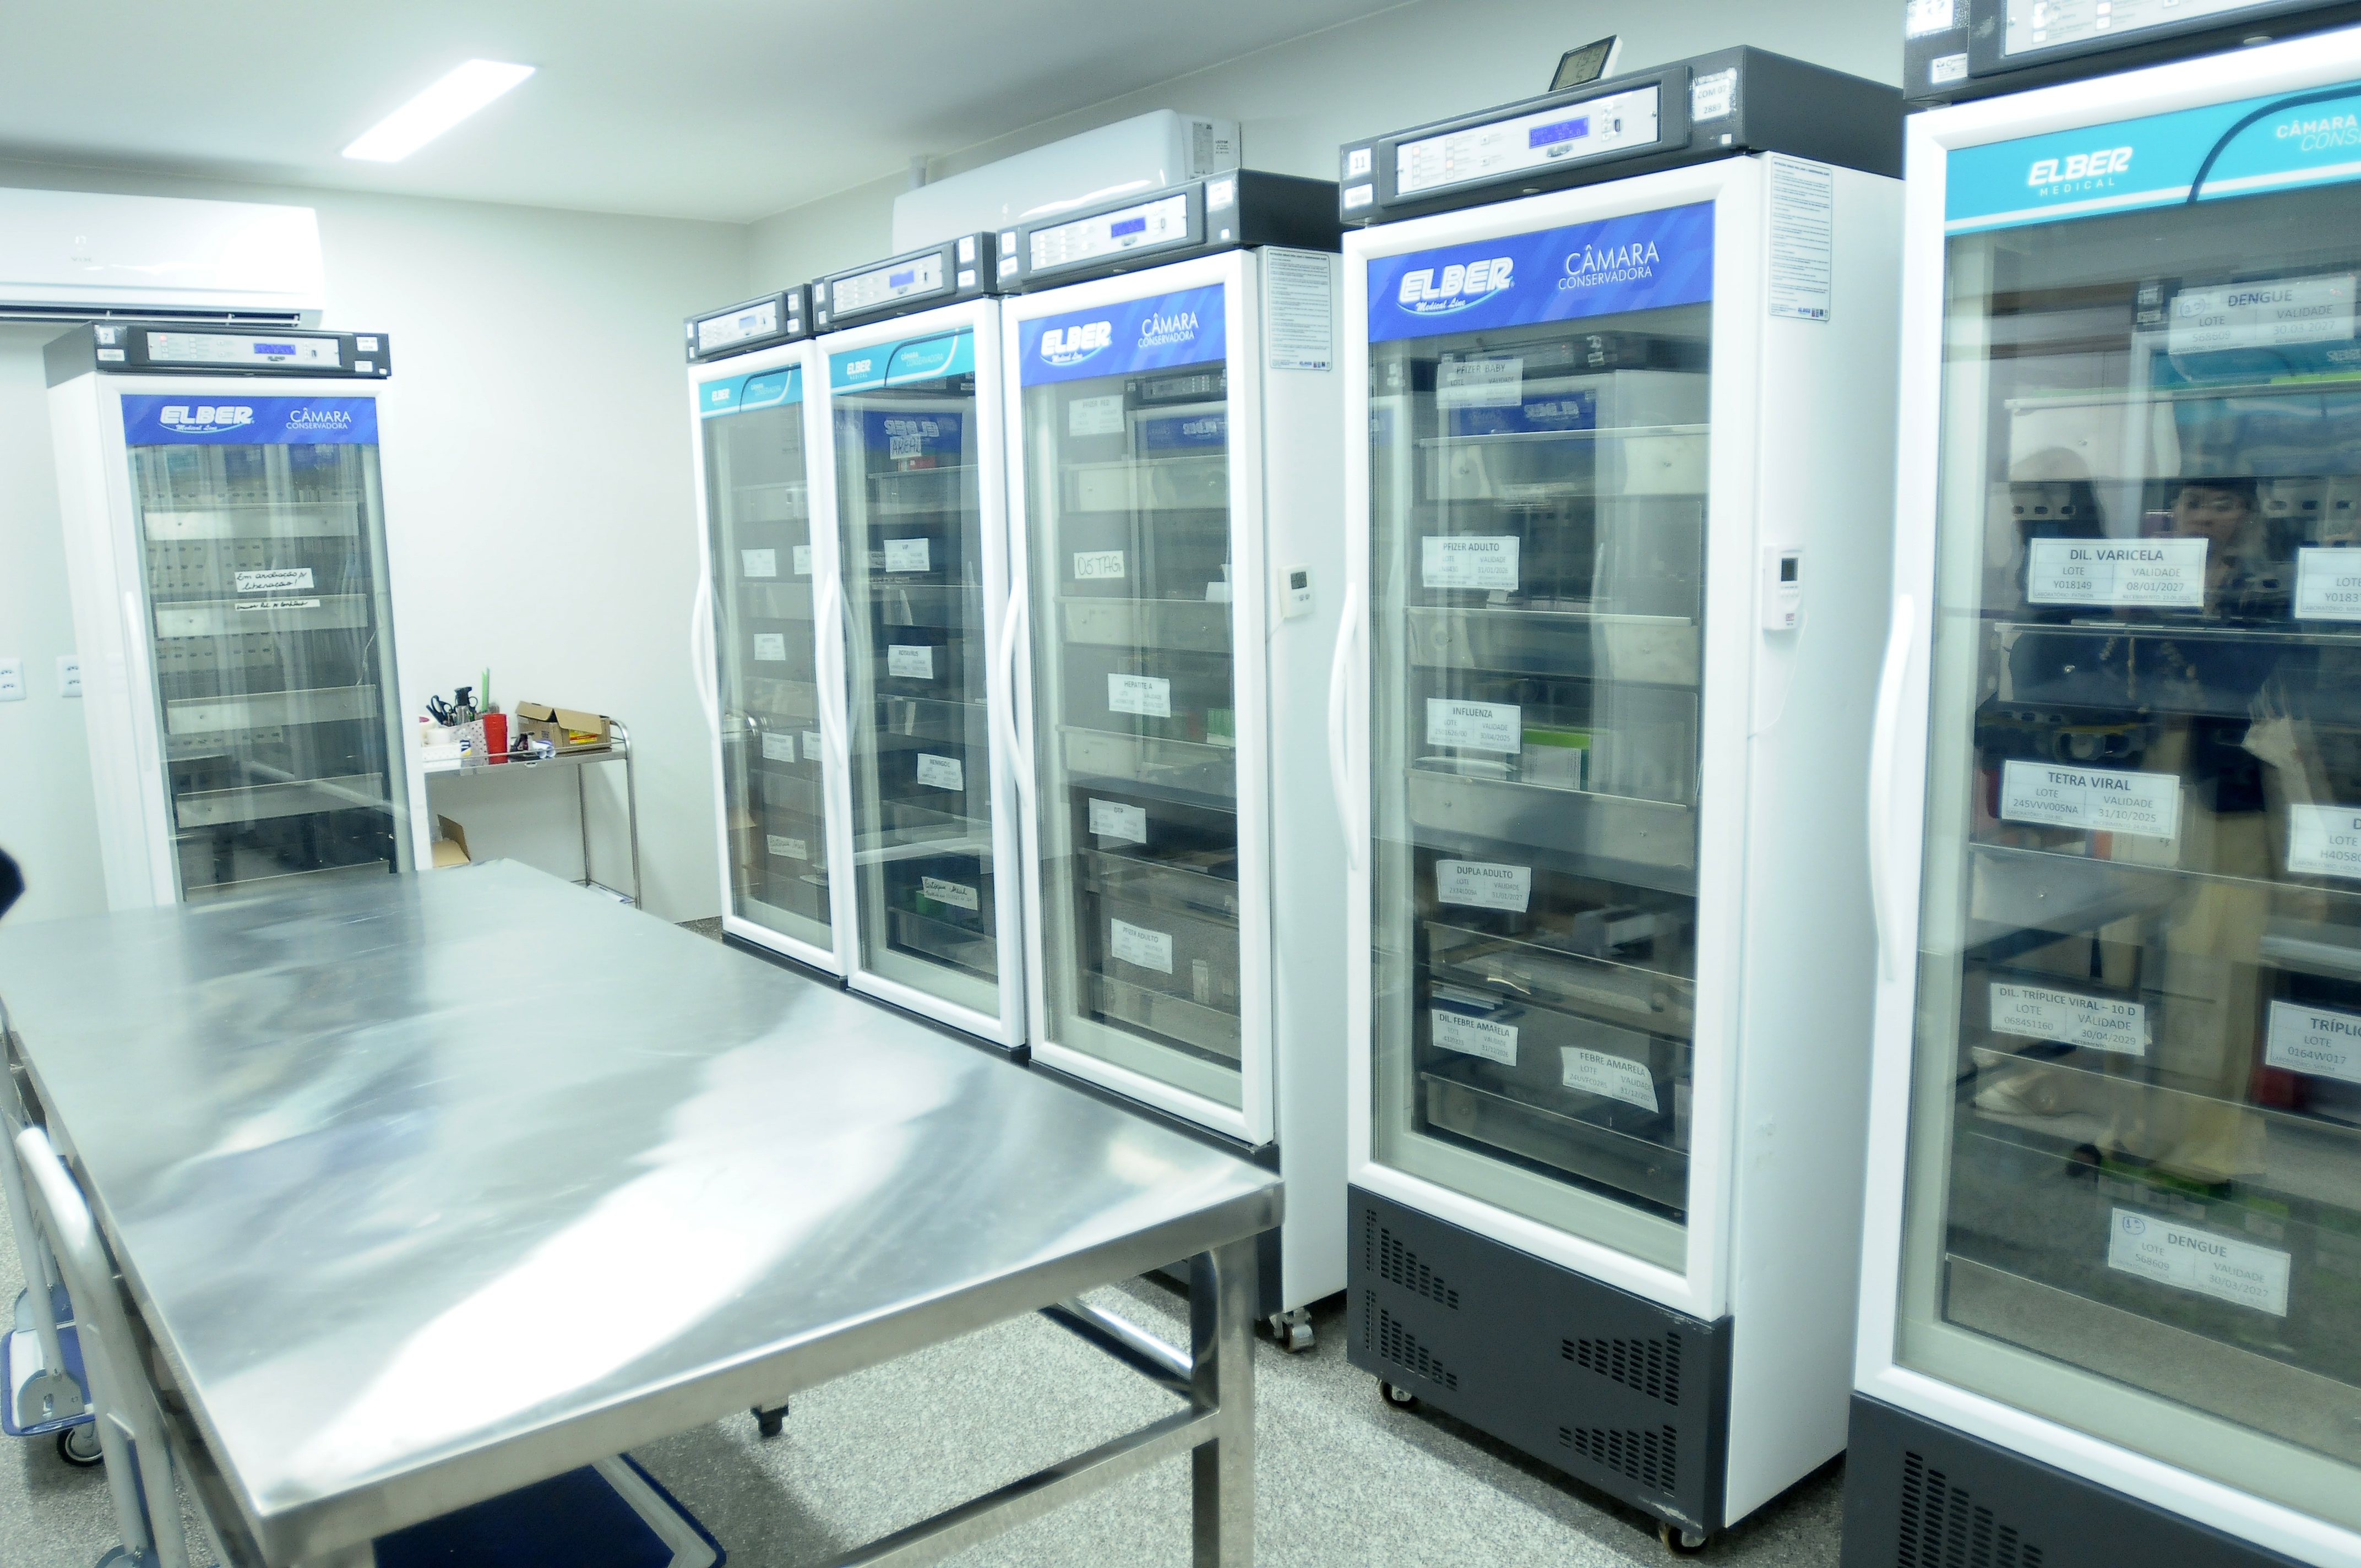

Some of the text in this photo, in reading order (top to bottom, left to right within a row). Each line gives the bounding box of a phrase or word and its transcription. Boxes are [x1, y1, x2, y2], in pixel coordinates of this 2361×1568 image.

[1698, 85, 1727, 99] COM 07
[1704, 103, 1721, 113] 2889
[2277, 114, 2358, 138] CÂMARA
[2302, 127, 2361, 151] CONS
[1354, 156, 1365, 169] 11
[2028, 146, 2133, 187] ELBER
[2039, 177, 2115, 197] MEDICAL
[1565, 241, 1660, 275] CÂMARA
[1399, 257, 1514, 302] ELBER
[1558, 266, 1652, 290] CONSERVADORA
[1416, 297, 1466, 312] Medical Line
[2228, 290, 2293, 307] DENGUE
[2277, 305, 2333, 319] VALIDADE
[1141, 311, 1199, 337] CÂMARA
[2200, 315, 2225, 327] LOTE
[1041, 320, 1111, 356] ELBER
[1138, 330, 1195, 348] CONSERVADORA
[847, 359, 871, 375] ELBER
[1456, 363, 1505, 374] PFIZER BABY
[160, 405, 253, 424] ELBER
[290, 407, 351, 423] CÂMARA
[286, 421, 348, 430] CONSERVADORA
[2070, 549, 2164, 561] DIL. VARICELA
[2063, 567, 2085, 575] LOTE
[2132, 568, 2181, 577] VALIDADE
[2053, 580, 2092, 590] Y018149
[2127, 582, 2184, 592] 08/01/2027
[2325, 593, 2361, 602] Y0183
[1124, 680, 1147, 689] HEPATITE
[1453, 707, 1493, 718] INFLUENZA
[1482, 723, 1508, 731] VALIDADE
[2048, 772, 2131, 791] TETRA VIRAL
[2036, 788, 2058, 798] LOTE
[2104, 796, 2153, 808] VALIDADE
[2098, 809, 2156, 822] 31/10/2025
[2330, 835, 2358, 846] LOTE
[1457, 866, 1513, 879] DUPLA ADULTO
[1494, 883, 1520, 891] VALIDADE
[1137, 932, 1158, 943] ADULTO
[2000, 988, 2019, 998] DIL.
[2022, 989, 2066, 1005] TRÍPLICE
[2069, 997, 2099, 1011] VIRAL
[2112, 1005, 2124, 1014] 10
[2128, 1007, 2136, 1016] D
[2016, 1004, 2042, 1015] LOTE
[1454, 1017, 1475, 1028] FEBRE
[1477, 1022, 1510, 1037] AMARELA
[2078, 1014, 2131, 1031] VALIDADE
[2081, 1029, 2136, 1045] 30/04/2029
[2304, 1035, 2332, 1048] LOTE
[2288, 1047, 2347, 1064] 0164W017
[1580, 1052, 1646, 1077] FEBRE AMARELA
[1580, 1065, 1597, 1075] LOTE
[2142, 1242, 2165, 1256] LOTE
[2167, 1233, 2227, 1257] DENGUE
[2136, 1254, 2170, 1271] 568609
[2213, 1262, 2265, 1283] VALIDADE
[2208, 1274, 2268, 1297] 30/03/2027
